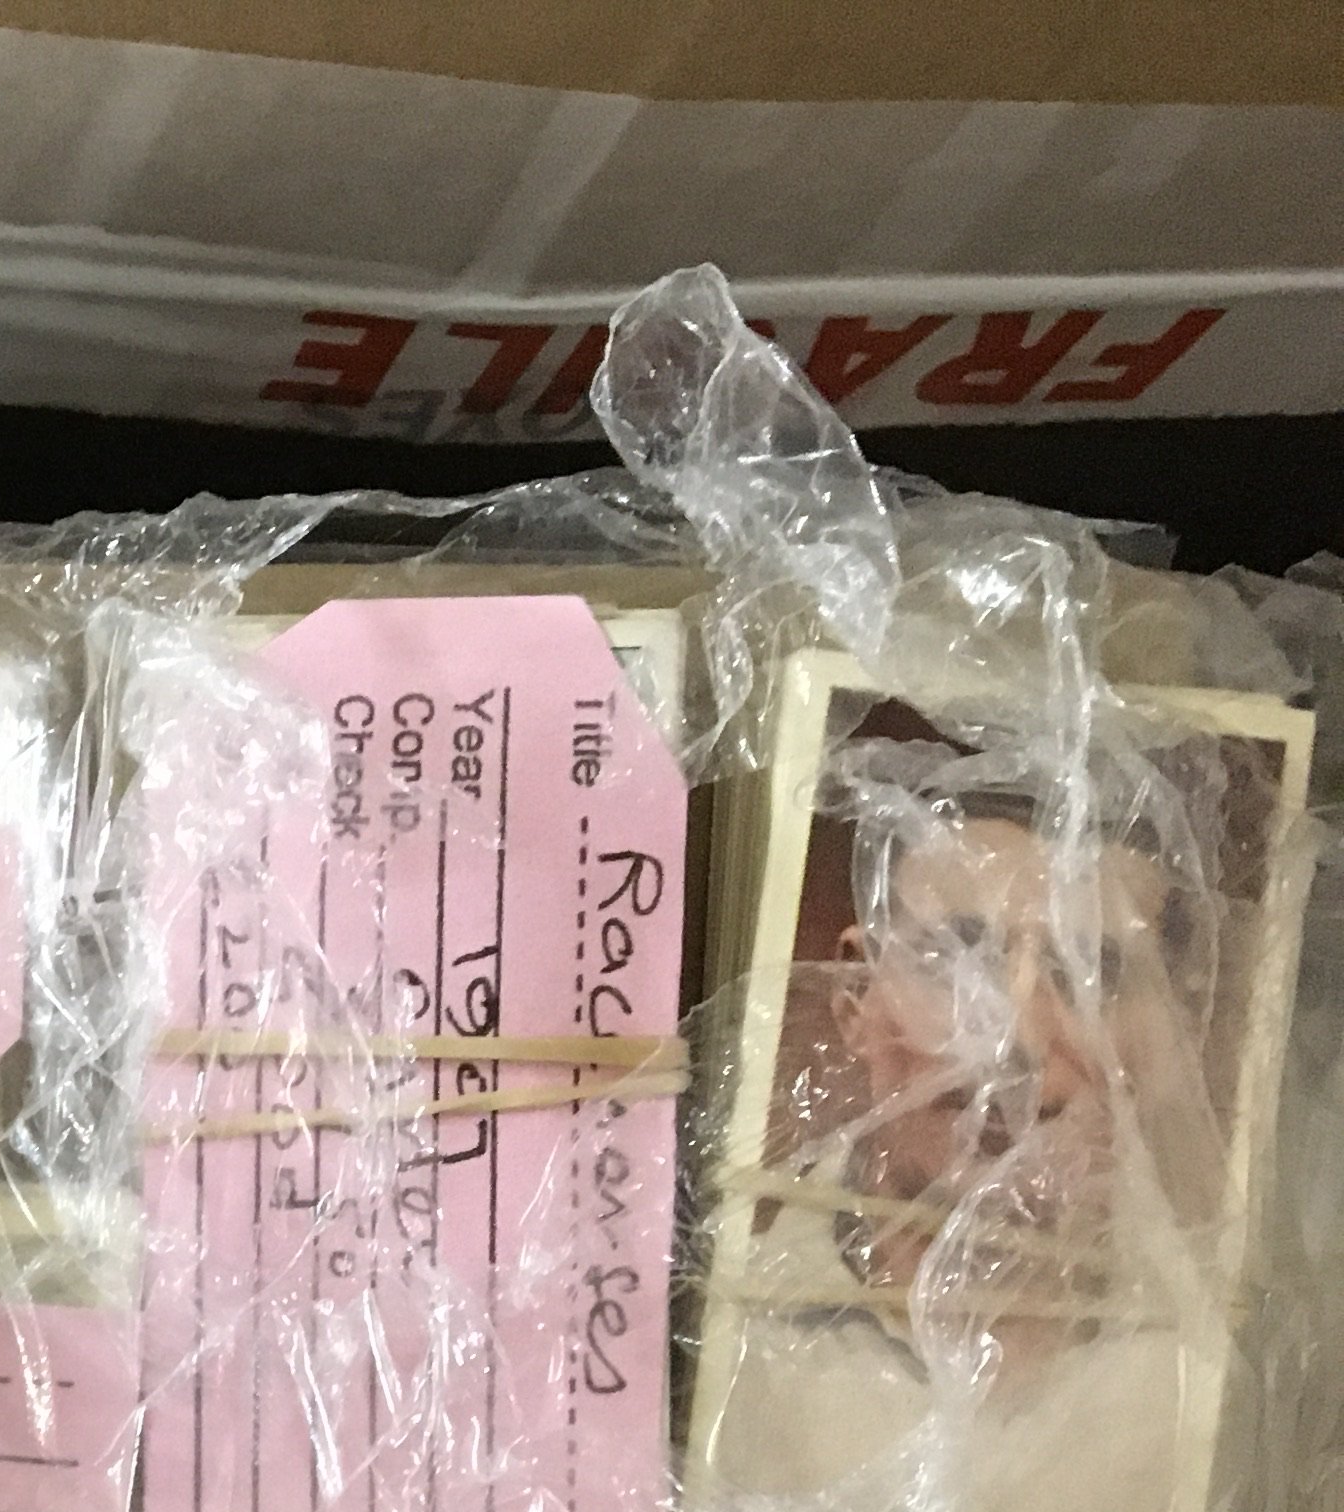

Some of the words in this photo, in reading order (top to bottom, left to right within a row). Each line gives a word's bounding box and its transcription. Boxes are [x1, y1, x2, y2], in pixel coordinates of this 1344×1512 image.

[259, 308, 1226, 410] FRAILE
[333, 695, 375, 840] Check
[449, 686, 498, 800] Year
